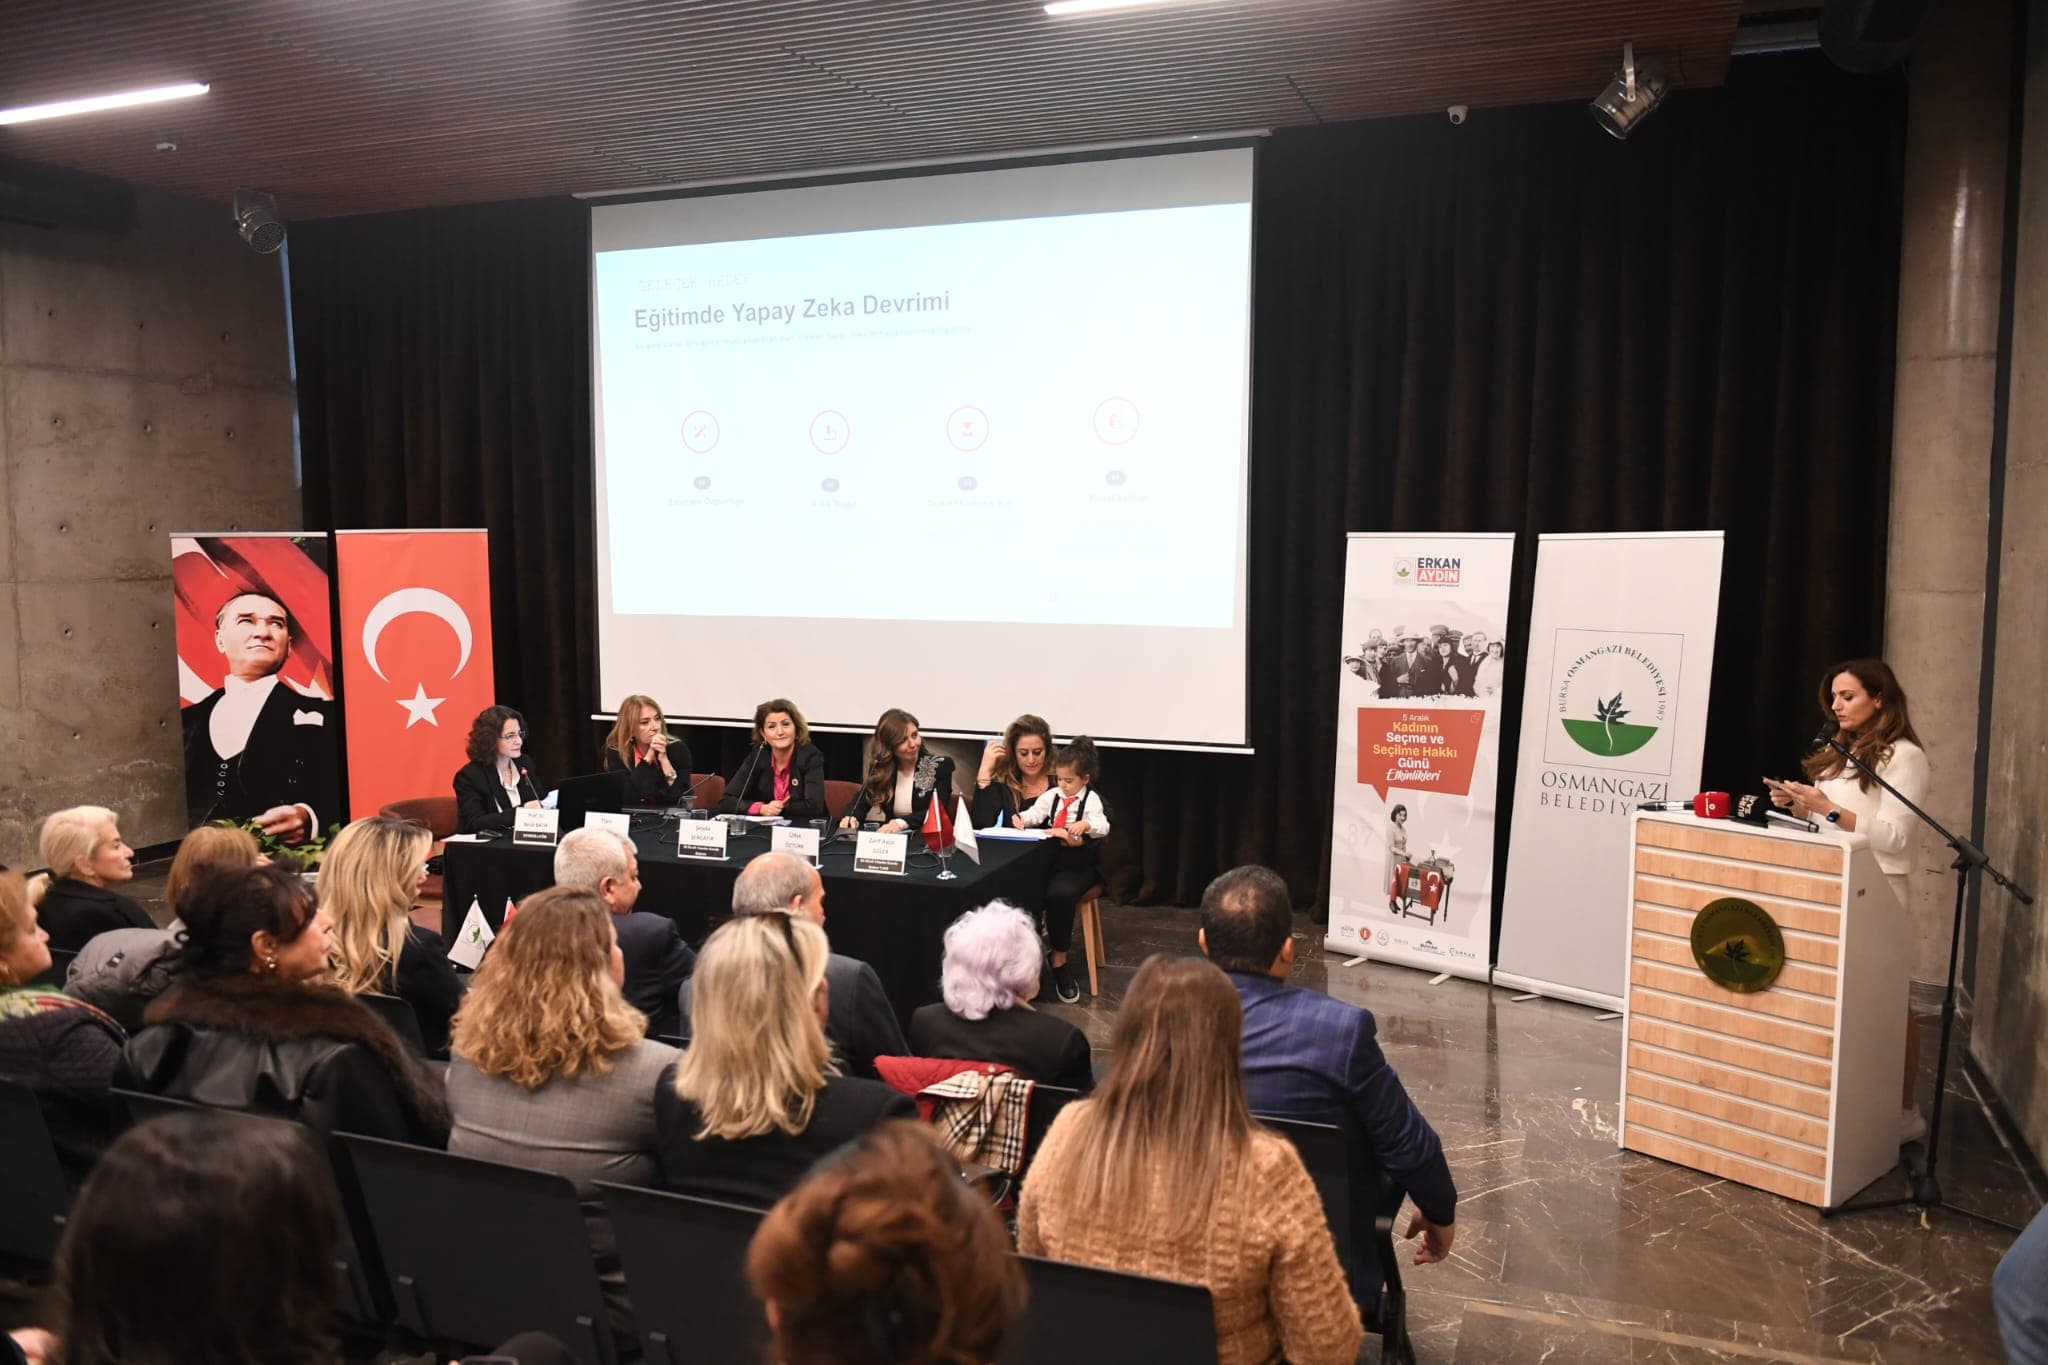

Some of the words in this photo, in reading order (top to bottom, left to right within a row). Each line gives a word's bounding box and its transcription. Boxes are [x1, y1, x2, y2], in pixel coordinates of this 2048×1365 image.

[634, 307, 725, 332] Eğitimde
[732, 302, 796, 326] Yapay
[802, 297, 855, 318] Zeka
[863, 290, 950, 314] Devrimi
[1417, 557, 1461, 569] ERKAN
[1418, 570, 1458, 582] AYDIN
[1559, 680, 1571, 713] BURSA
[1402, 713, 1408, 722] 5
[1392, 721, 1439, 734] Kadının
[1386, 732, 1427, 746] Seçme
[1430, 736, 1445, 745] ve
[1373, 744, 1420, 757] Seçilme
[1422, 746, 1457, 758] Hakkı
[1397, 757, 1430, 769] Günü
[1386, 768, 1442, 782] Etkinlikleri
[1541, 770, 1669, 801] OSMANGAZİ
